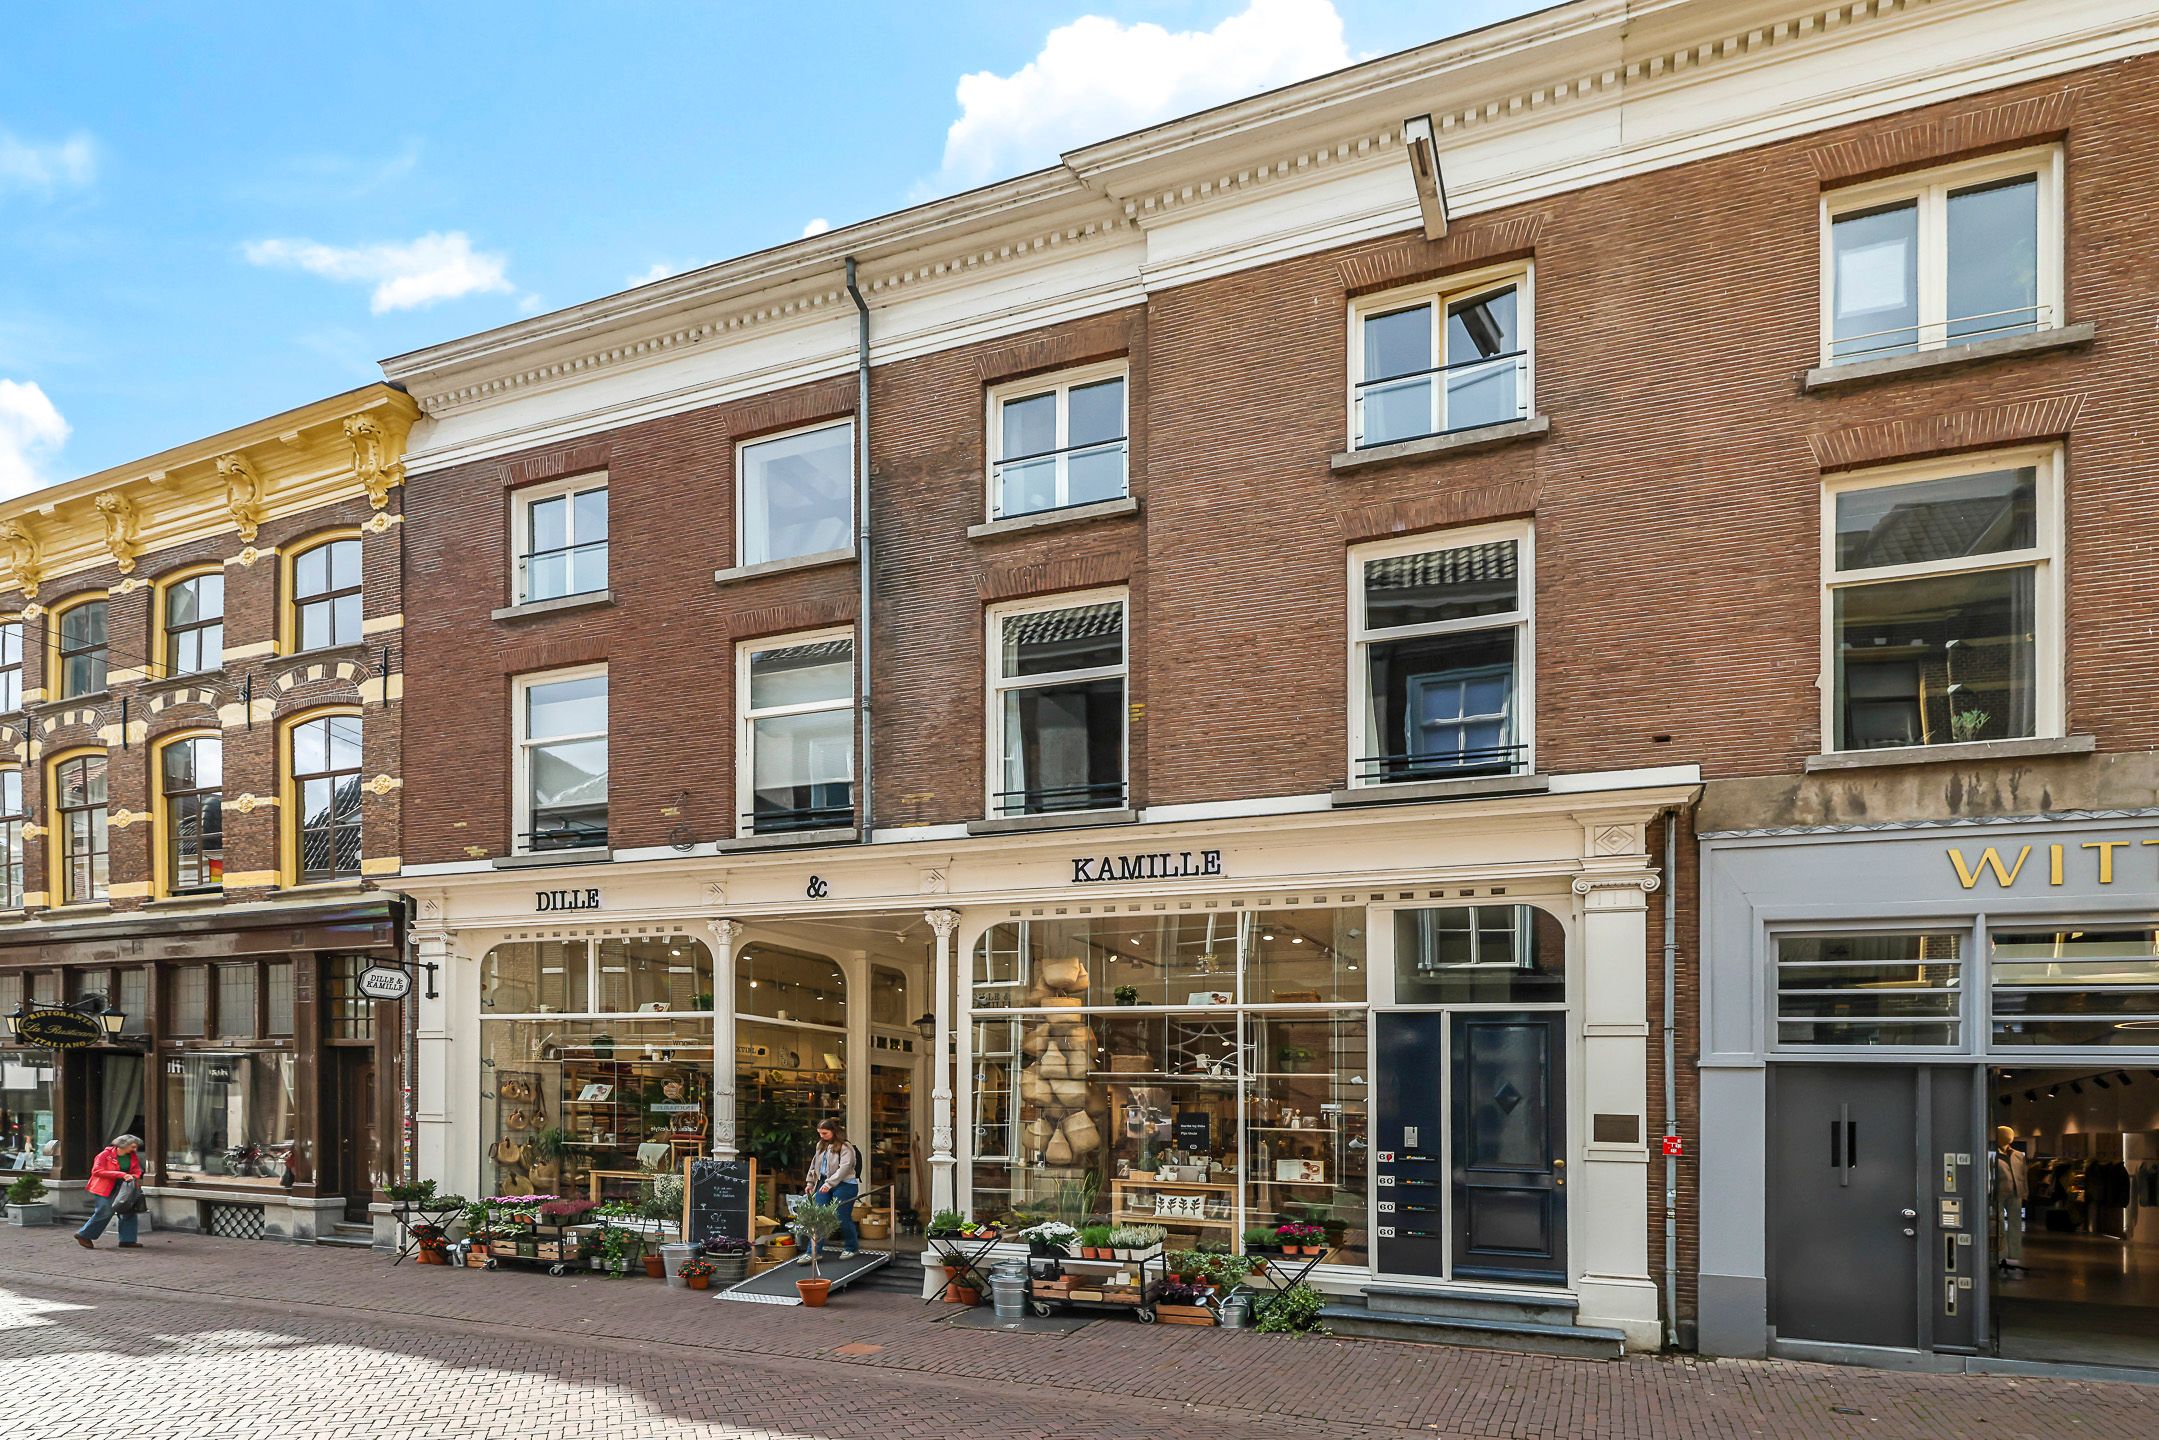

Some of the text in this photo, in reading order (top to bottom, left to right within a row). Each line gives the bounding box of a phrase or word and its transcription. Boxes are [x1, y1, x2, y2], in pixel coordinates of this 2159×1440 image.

[1947, 839, 2159, 889] WIT
[535, 849, 1221, 911] DILLE & KAMILLE
[366, 980, 404, 991] KAMILLE
[370, 974, 403, 985] DILLE &
[28, 1010, 95, 1027] RISTORANTE
[34, 1036, 87, 1048] ITALIANO
